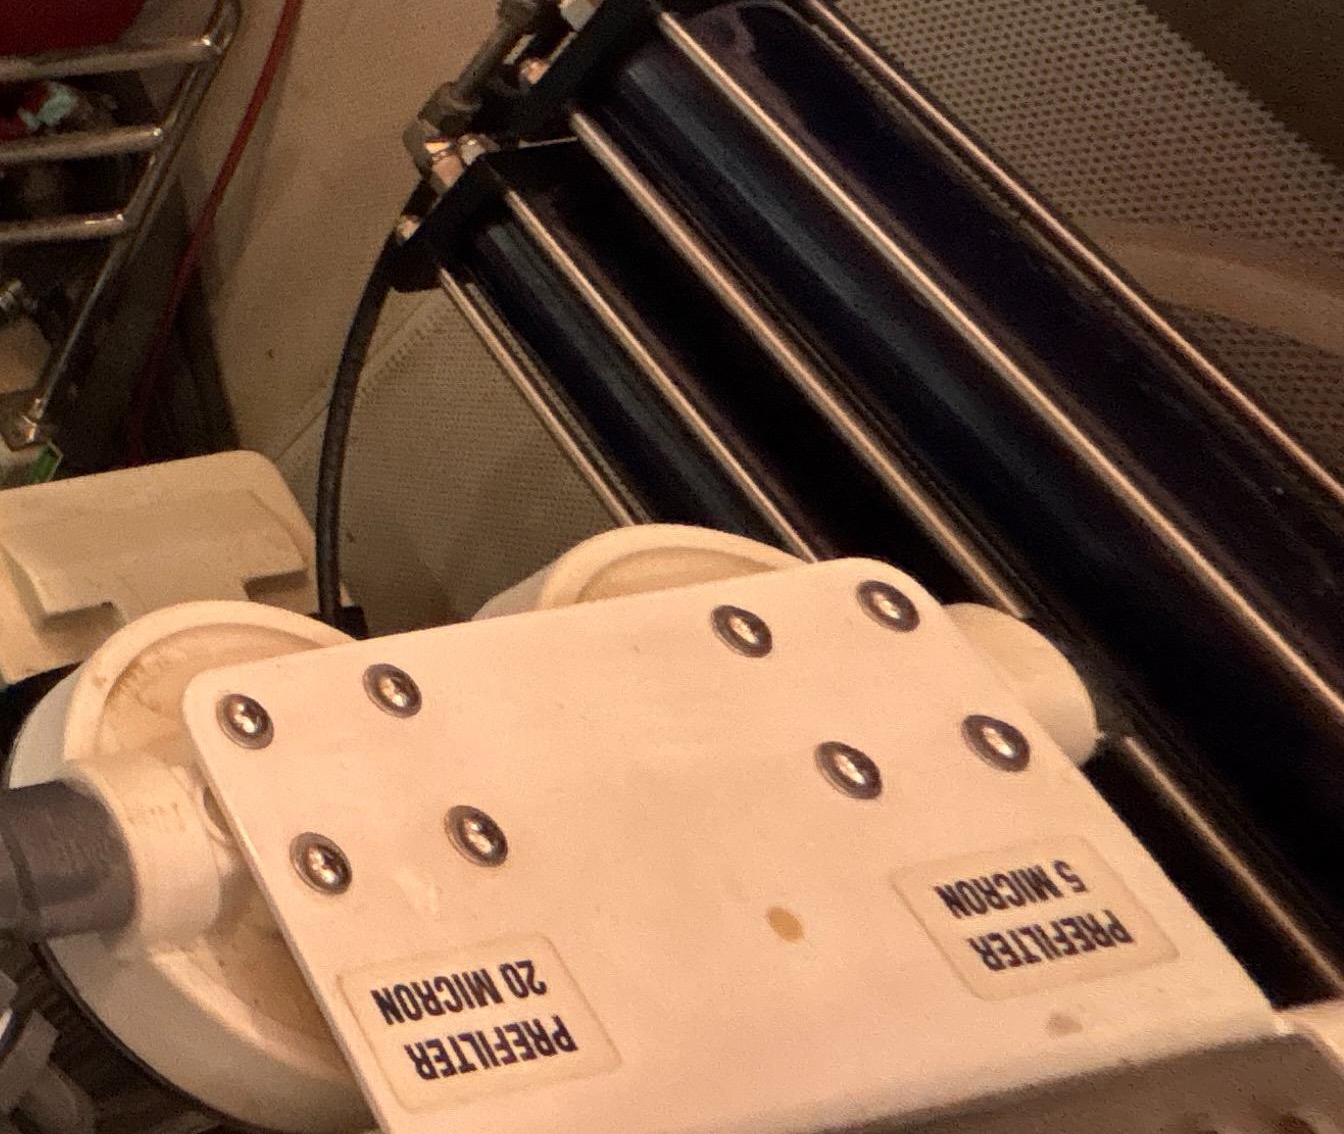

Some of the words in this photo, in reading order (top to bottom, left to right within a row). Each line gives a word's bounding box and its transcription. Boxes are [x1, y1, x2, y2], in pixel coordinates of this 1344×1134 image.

[933, 864, 1064, 919] MICRON
[1052, 859, 1088, 894] 5
[966, 909, 1135, 972] PREFILTER
[370, 968, 504, 1025] MICRON
[499, 959, 547, 999] 20
[403, 1015, 579, 1080] PREFILTER
